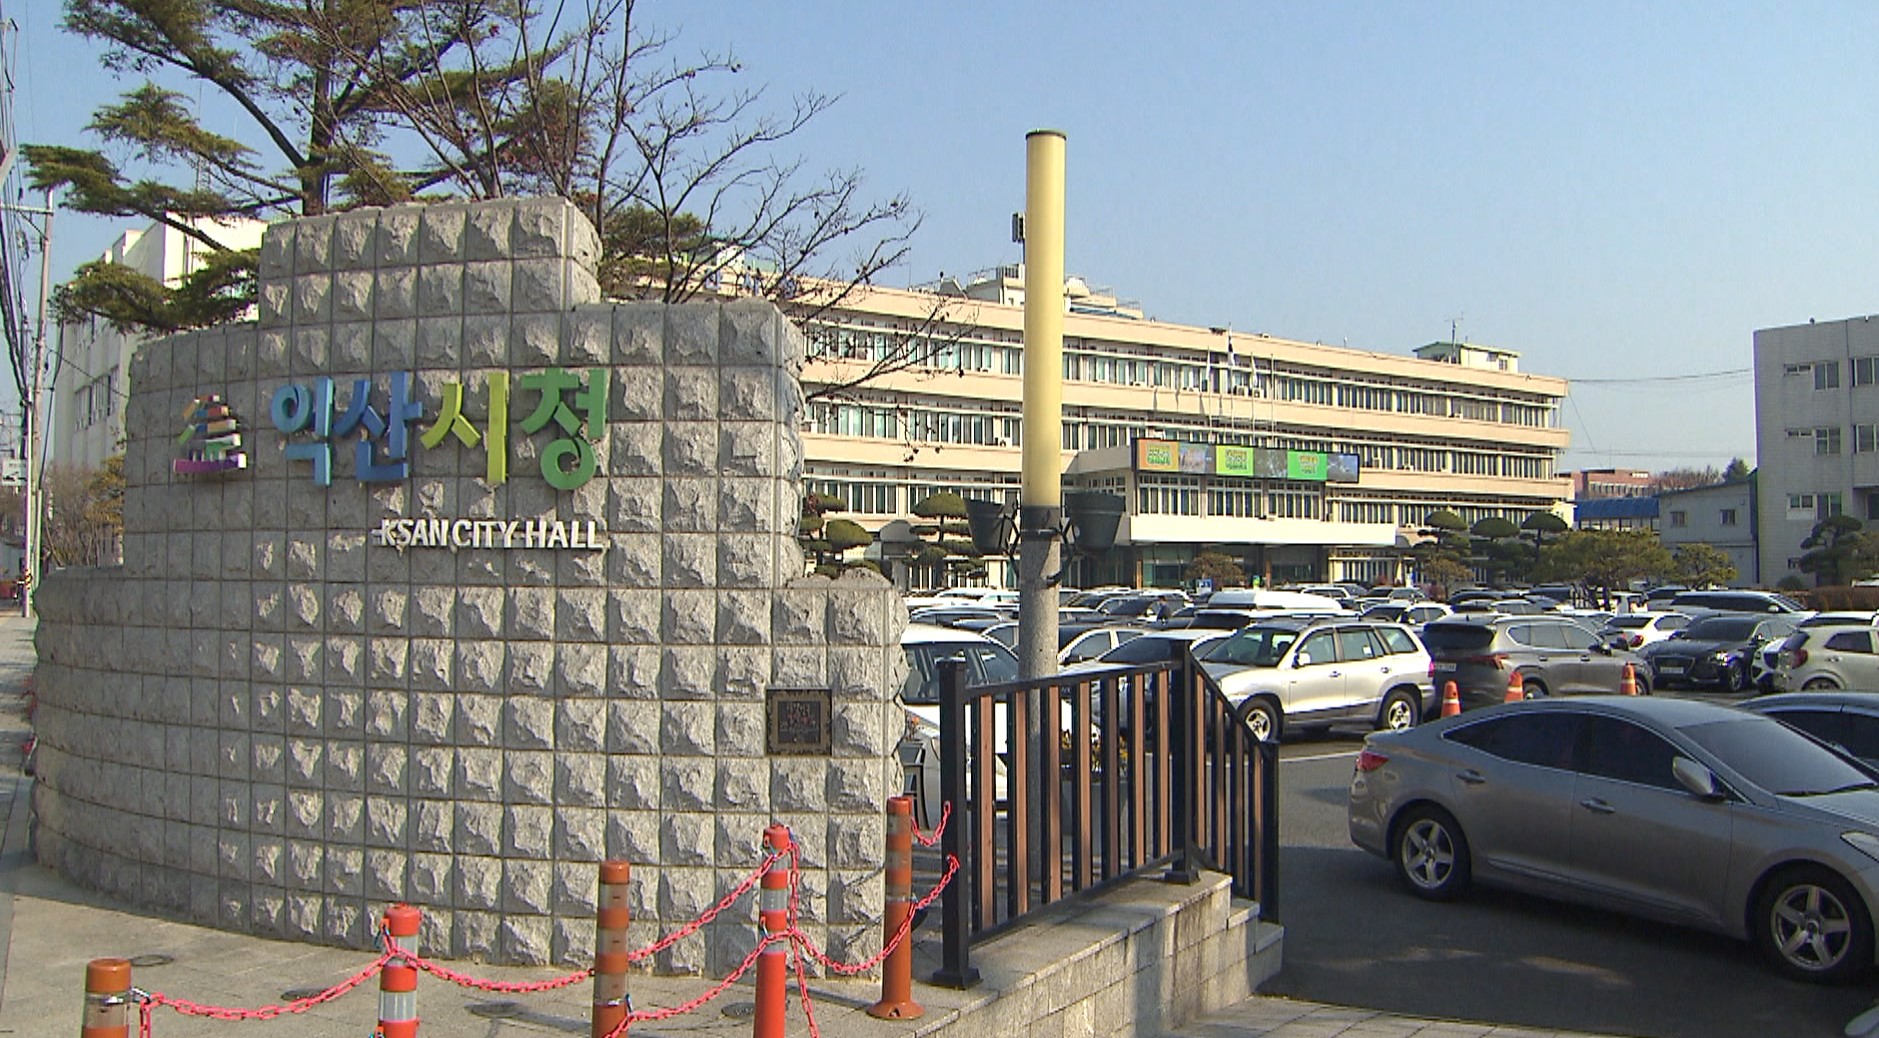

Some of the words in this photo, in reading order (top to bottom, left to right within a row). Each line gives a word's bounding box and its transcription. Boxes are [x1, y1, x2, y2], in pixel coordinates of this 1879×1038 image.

[270, 367, 607, 490] 익산시청
[452, 519, 519, 549] CITY
[526, 520, 604, 549] HALL
